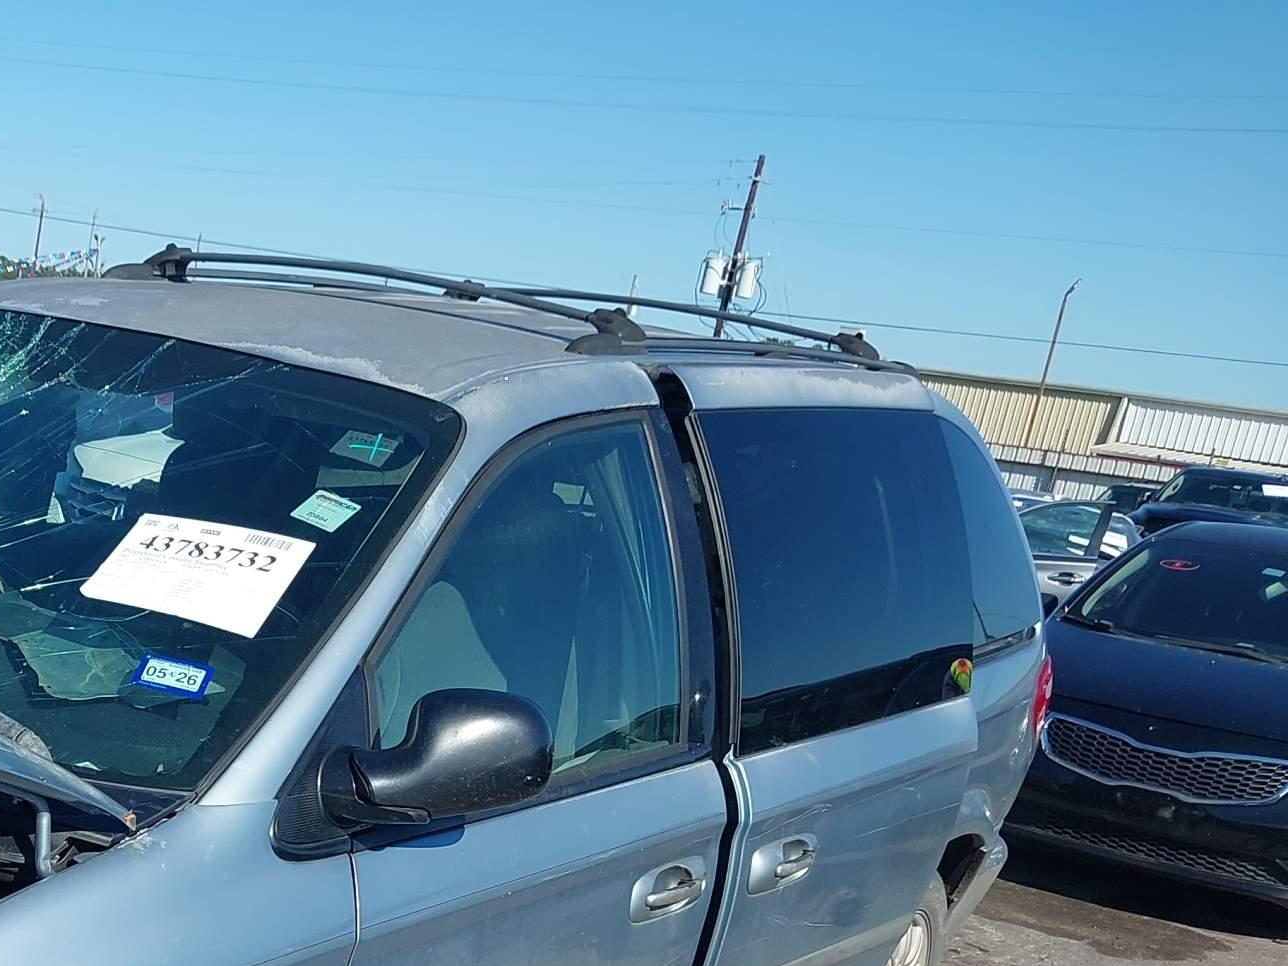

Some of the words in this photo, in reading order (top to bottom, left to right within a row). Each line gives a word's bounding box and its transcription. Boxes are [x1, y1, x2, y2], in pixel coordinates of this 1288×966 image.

[139, 535, 278, 573] 43783732
[146, 666, 168, 679] 05
[176, 671, 199, 686] 26
